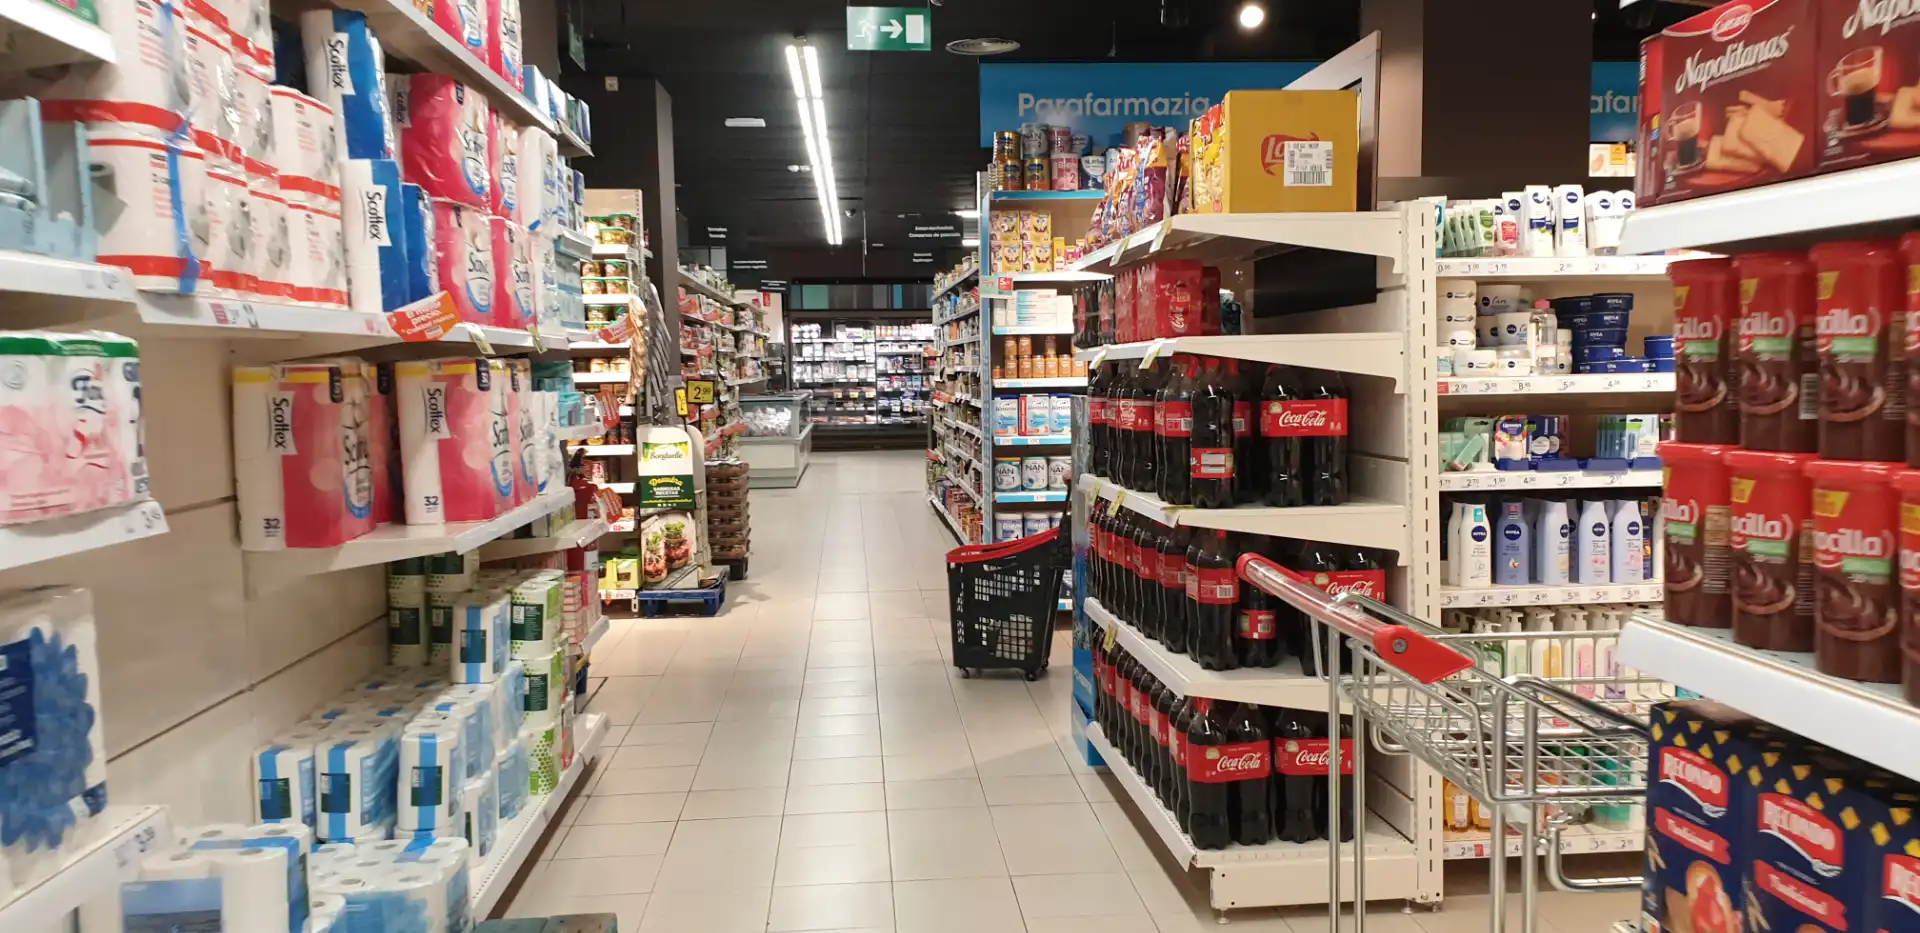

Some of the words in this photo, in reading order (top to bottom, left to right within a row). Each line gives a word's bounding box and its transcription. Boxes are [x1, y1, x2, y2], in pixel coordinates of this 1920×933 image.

[327, 38, 345, 89] Scottex
[1675, 25, 1795, 94] Napolitanas
[1018, 92, 1210, 117] Parafarmazia
[365, 190, 382, 242] Scottex
[271, 396, 290, 449] Scottex
[426, 386, 442, 433] Scottex
[1026, 463, 1045, 471] NAN
[263, 517, 281, 530] 32
[424, 495, 439, 507] 32
